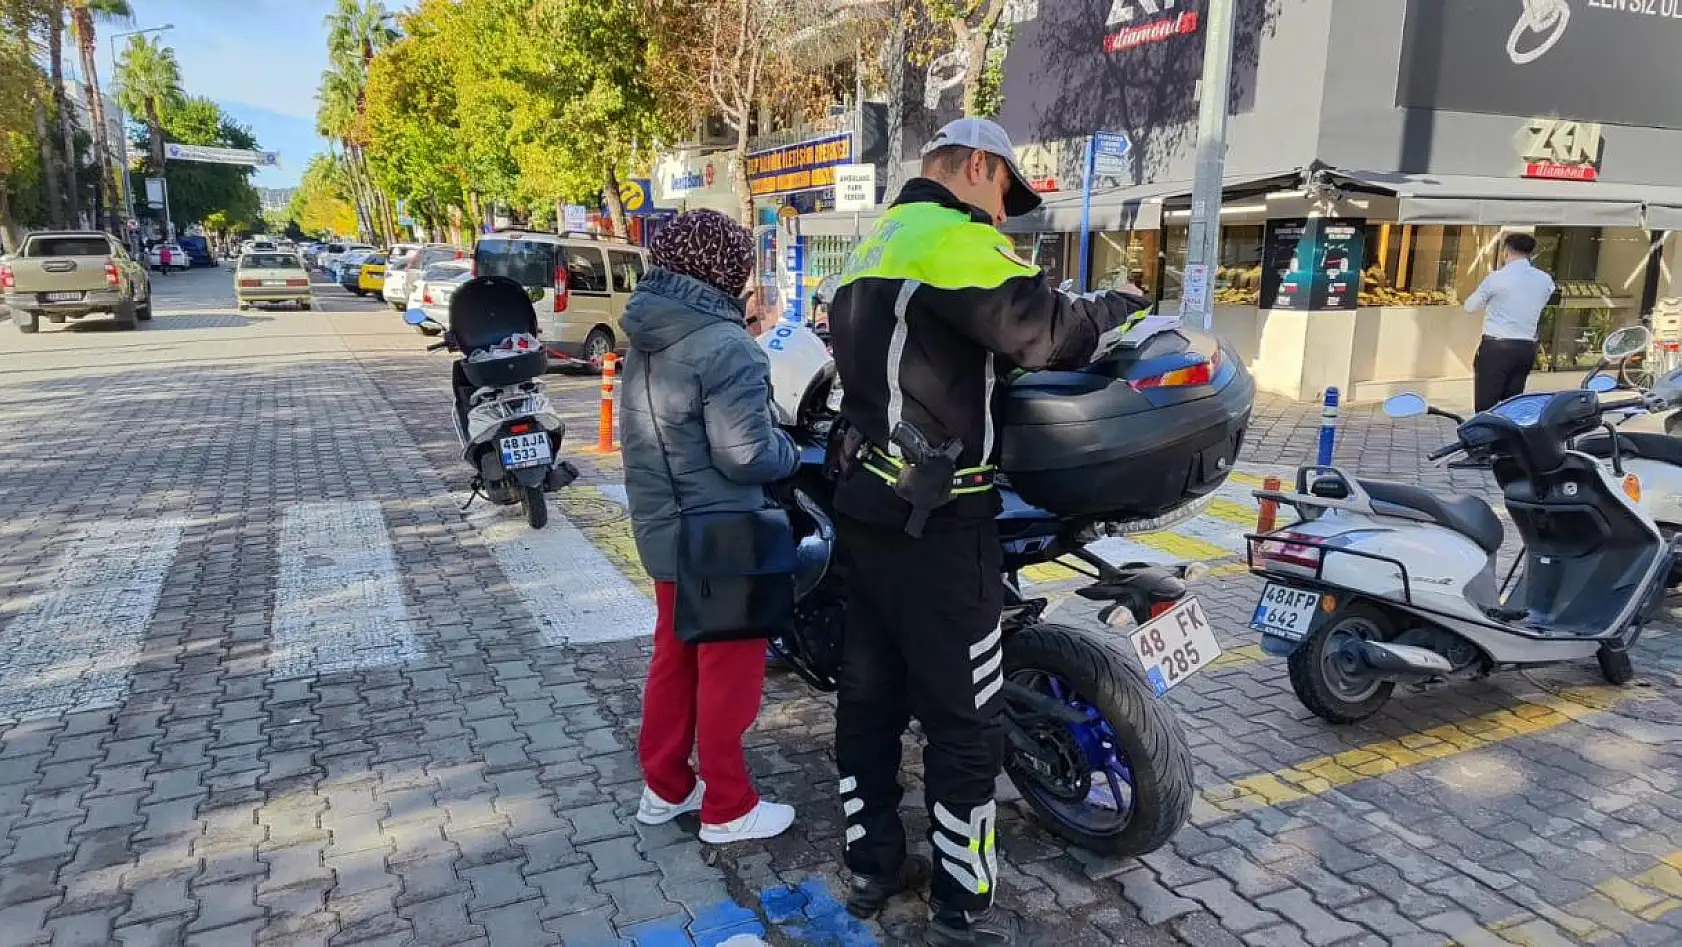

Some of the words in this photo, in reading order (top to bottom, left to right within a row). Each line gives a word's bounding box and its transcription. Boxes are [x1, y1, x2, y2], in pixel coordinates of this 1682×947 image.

[1113, 11, 1183, 48] diamond
[1520, 119, 1600, 163] ZEN
[1536, 160, 1585, 178] diamond
[504, 439, 518, 449] 48
[522, 434, 545, 447] AJA
[514, 448, 536, 460] 533
[1140, 628, 1164, 657] 48
[1175, 604, 1203, 637] FK
[1268, 608, 1297, 628] 642
[1162, 640, 1200, 680] 285
